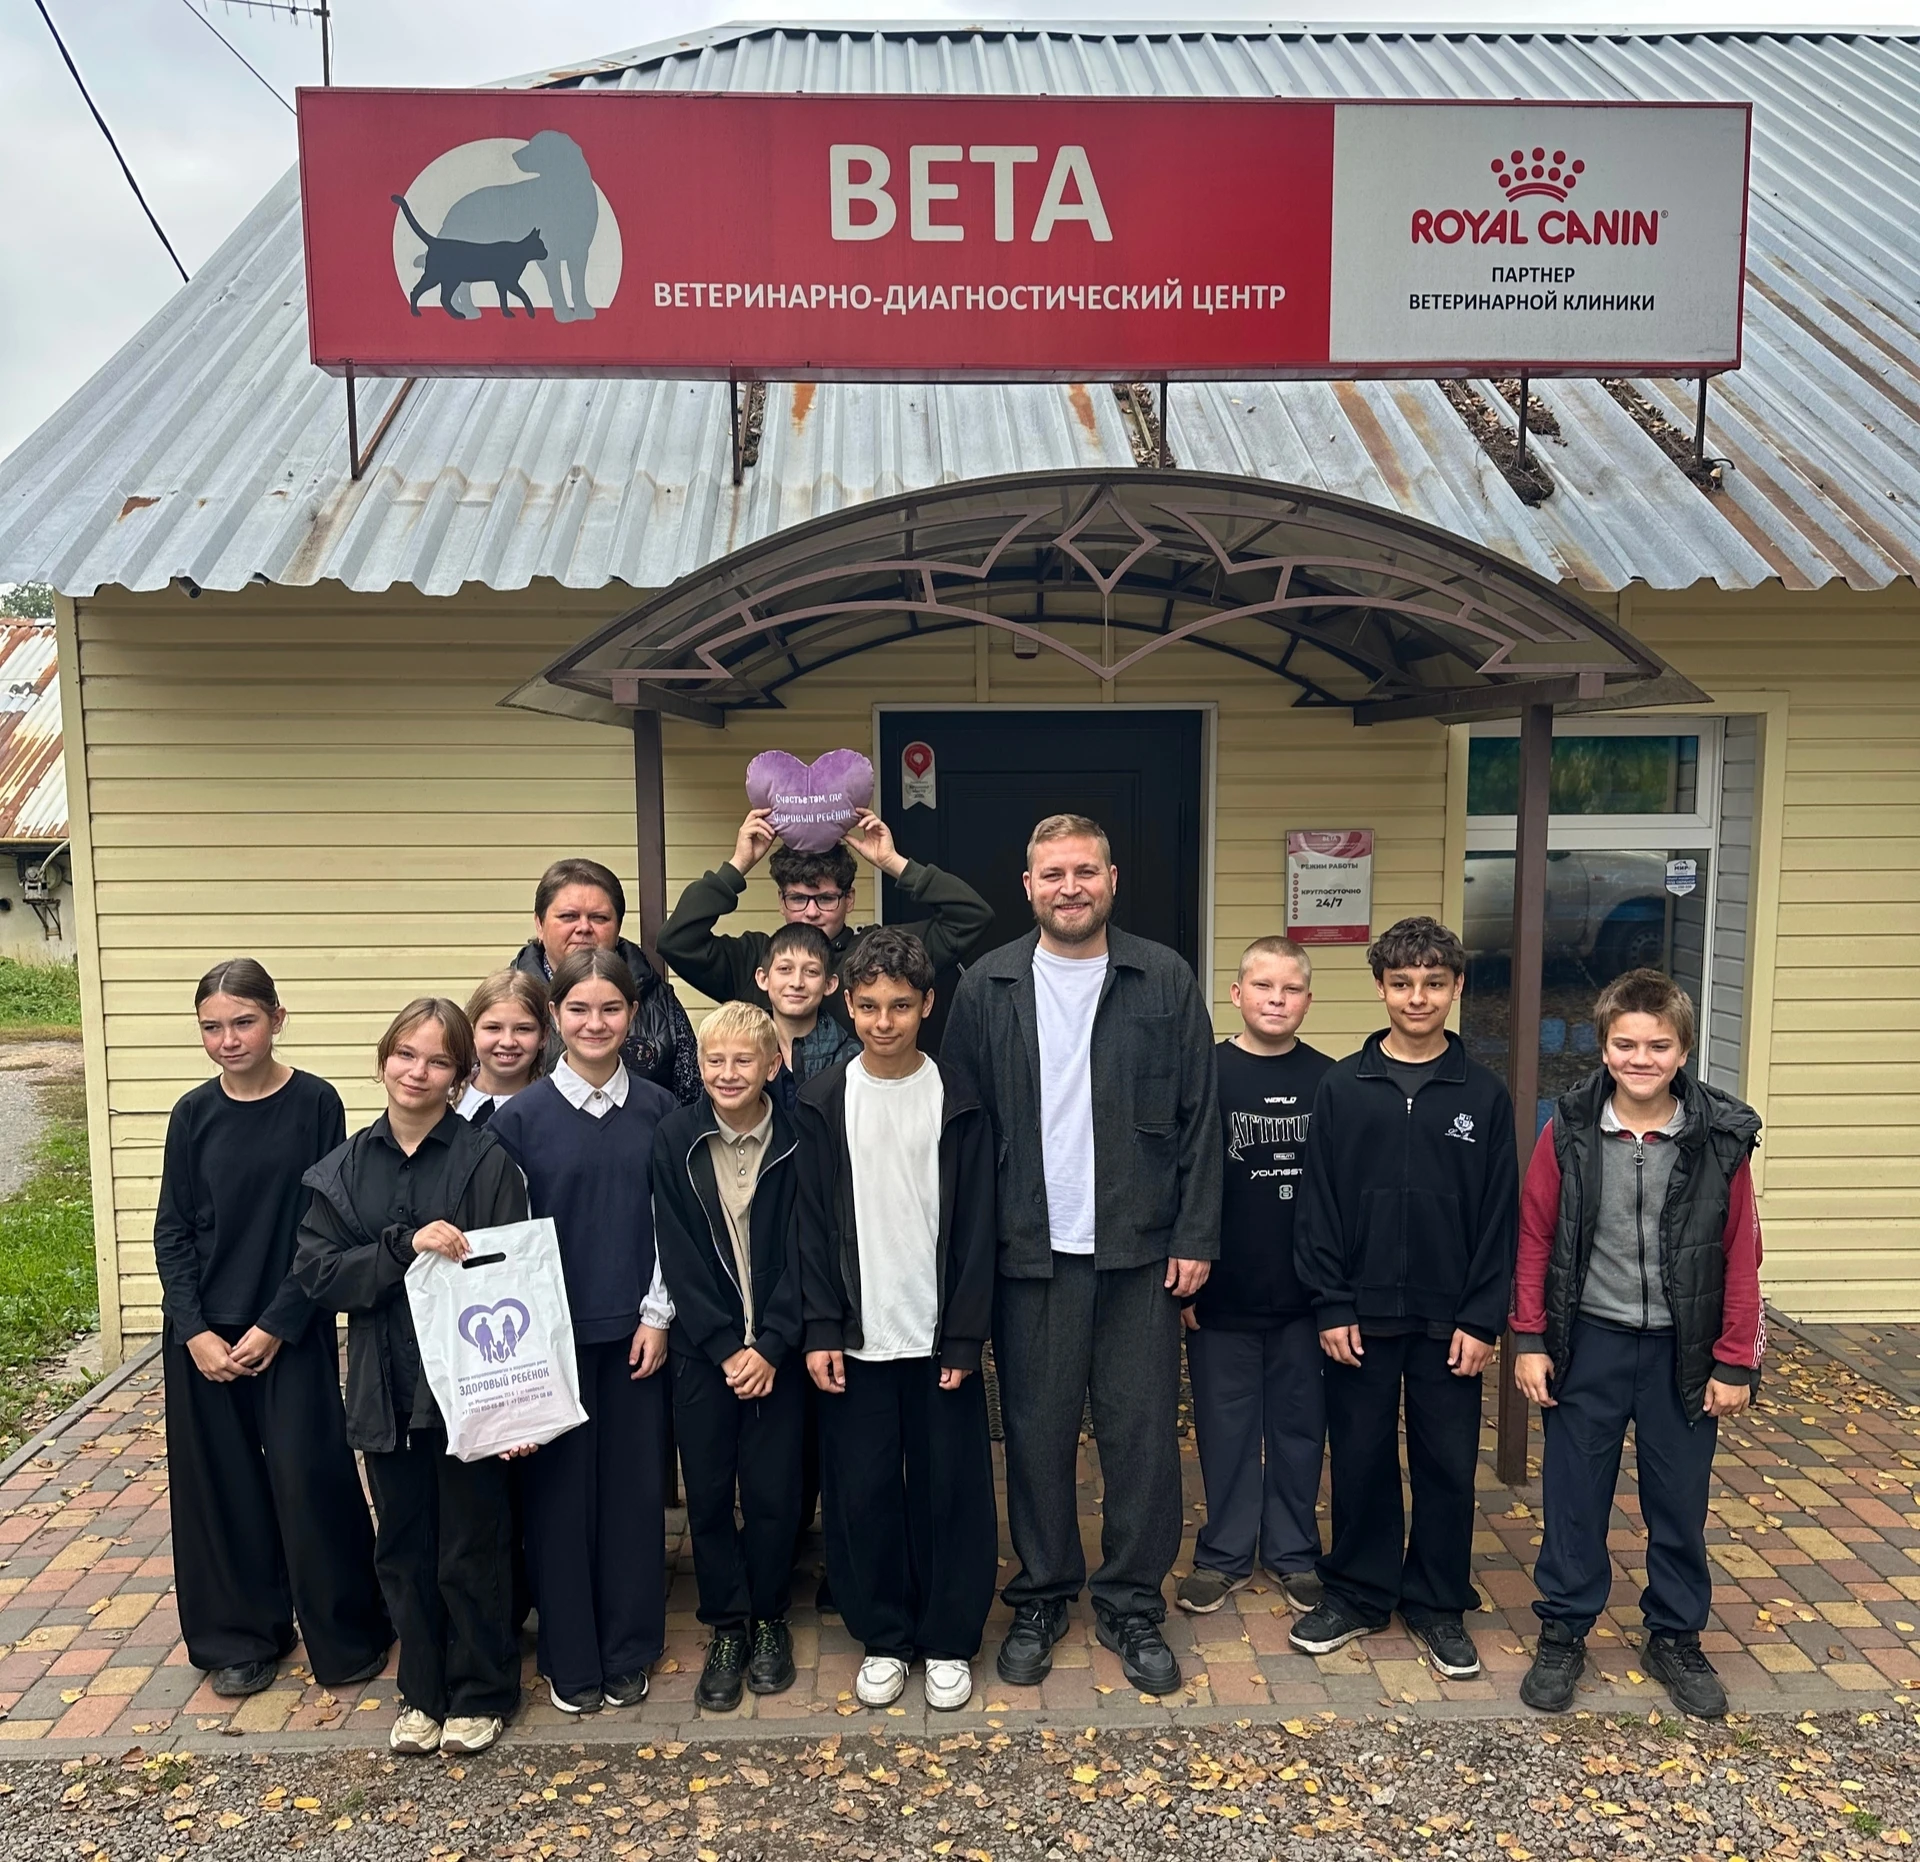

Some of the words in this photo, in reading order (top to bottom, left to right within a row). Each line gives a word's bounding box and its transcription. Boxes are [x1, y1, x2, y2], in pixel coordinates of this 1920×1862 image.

[829, 144, 1113, 242] ВЕТА
[1411, 209, 1529, 245] ROYAL
[1491, 266, 1576, 284] ПАРТНЕР
[653, 278, 1183, 316] ВЕТЕРИНАРНО-ДИАГНОСТИЧЕСКИЙ
[1192, 284, 1287, 316] ЦЕНТР
[1408, 290, 1558, 311] ВЕТЕРИНАРНОЙ
[1562, 294, 1656, 312] КЛИНИКИ
[775, 793, 808, 804] Счастье
[828, 792, 843, 803] где
[1328, 862, 1359, 870] РАБОТЫ
[1301, 888, 1362, 896] КРУГЛОСУТОЧНО
[1315, 897, 1343, 908] 24/7
[1263, 1096, 1298, 1105] WORLD
[1228, 1111, 1312, 1156] ATTITU
[459, 1374, 509, 1396] ЗДОРОВЫЙ
[511, 1367, 550, 1384] РЕБЁНОК
